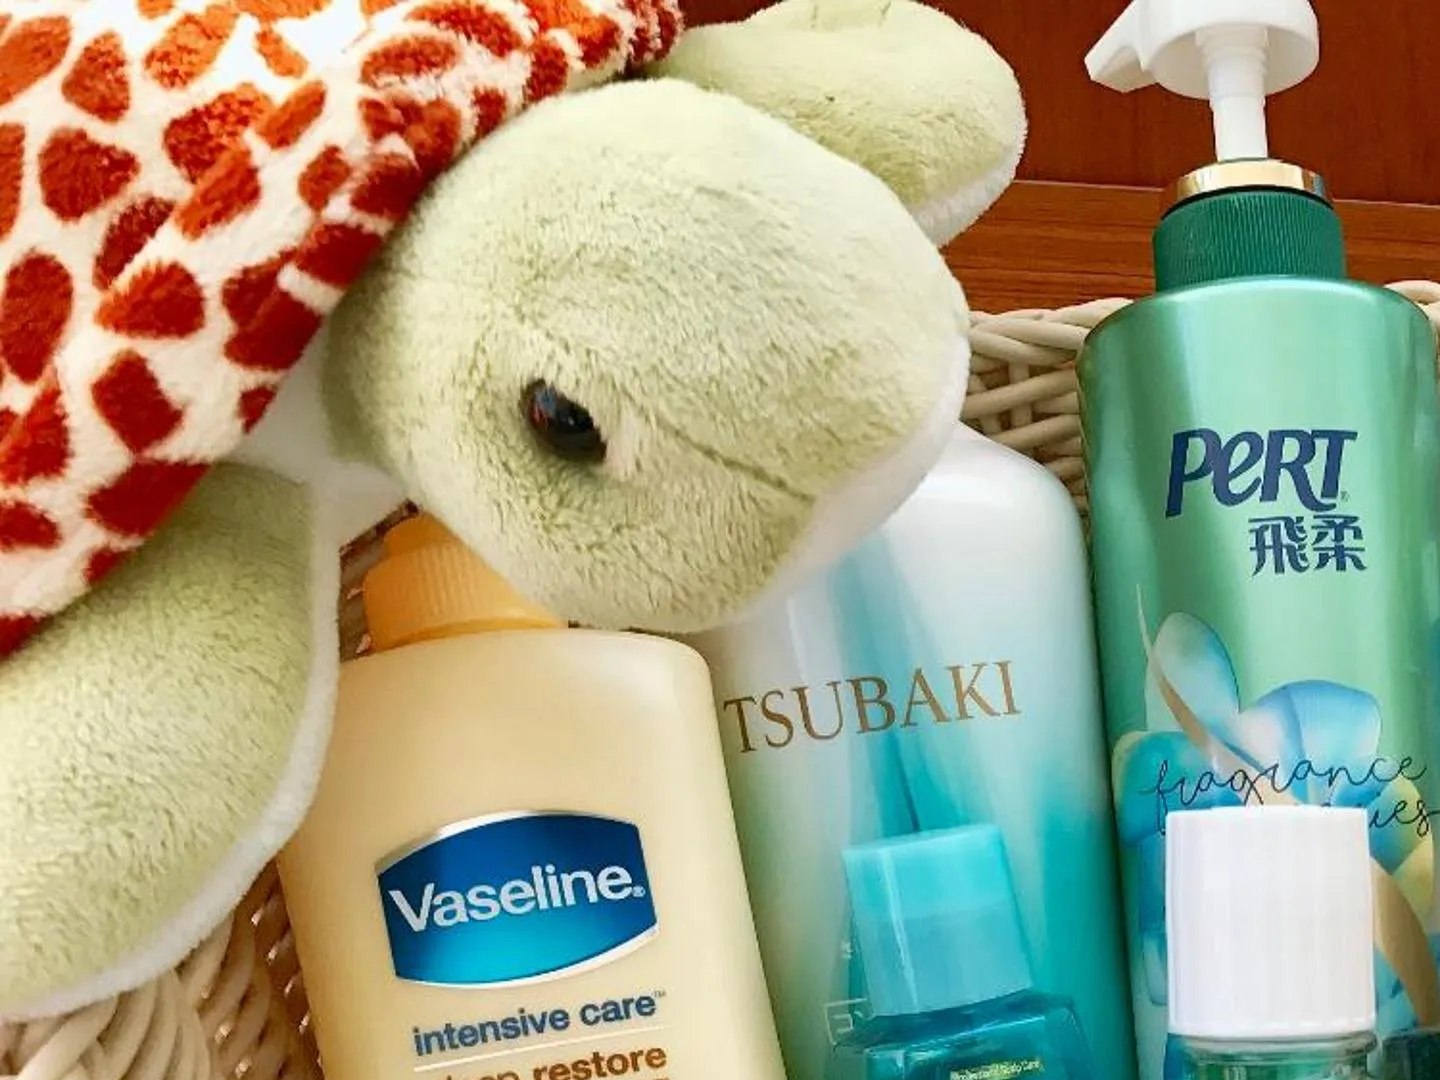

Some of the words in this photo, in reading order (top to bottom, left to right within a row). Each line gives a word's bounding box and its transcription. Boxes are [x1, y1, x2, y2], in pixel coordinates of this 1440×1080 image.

[1247, 513, 1368, 577] 飛柔
[723, 660, 1021, 753] TSUBAKI
[1138, 753, 1428, 815] fragrance
[388, 863, 644, 933] Vaseline
[411, 1006, 570, 1057] intensive
[580, 992, 657, 1027] care
